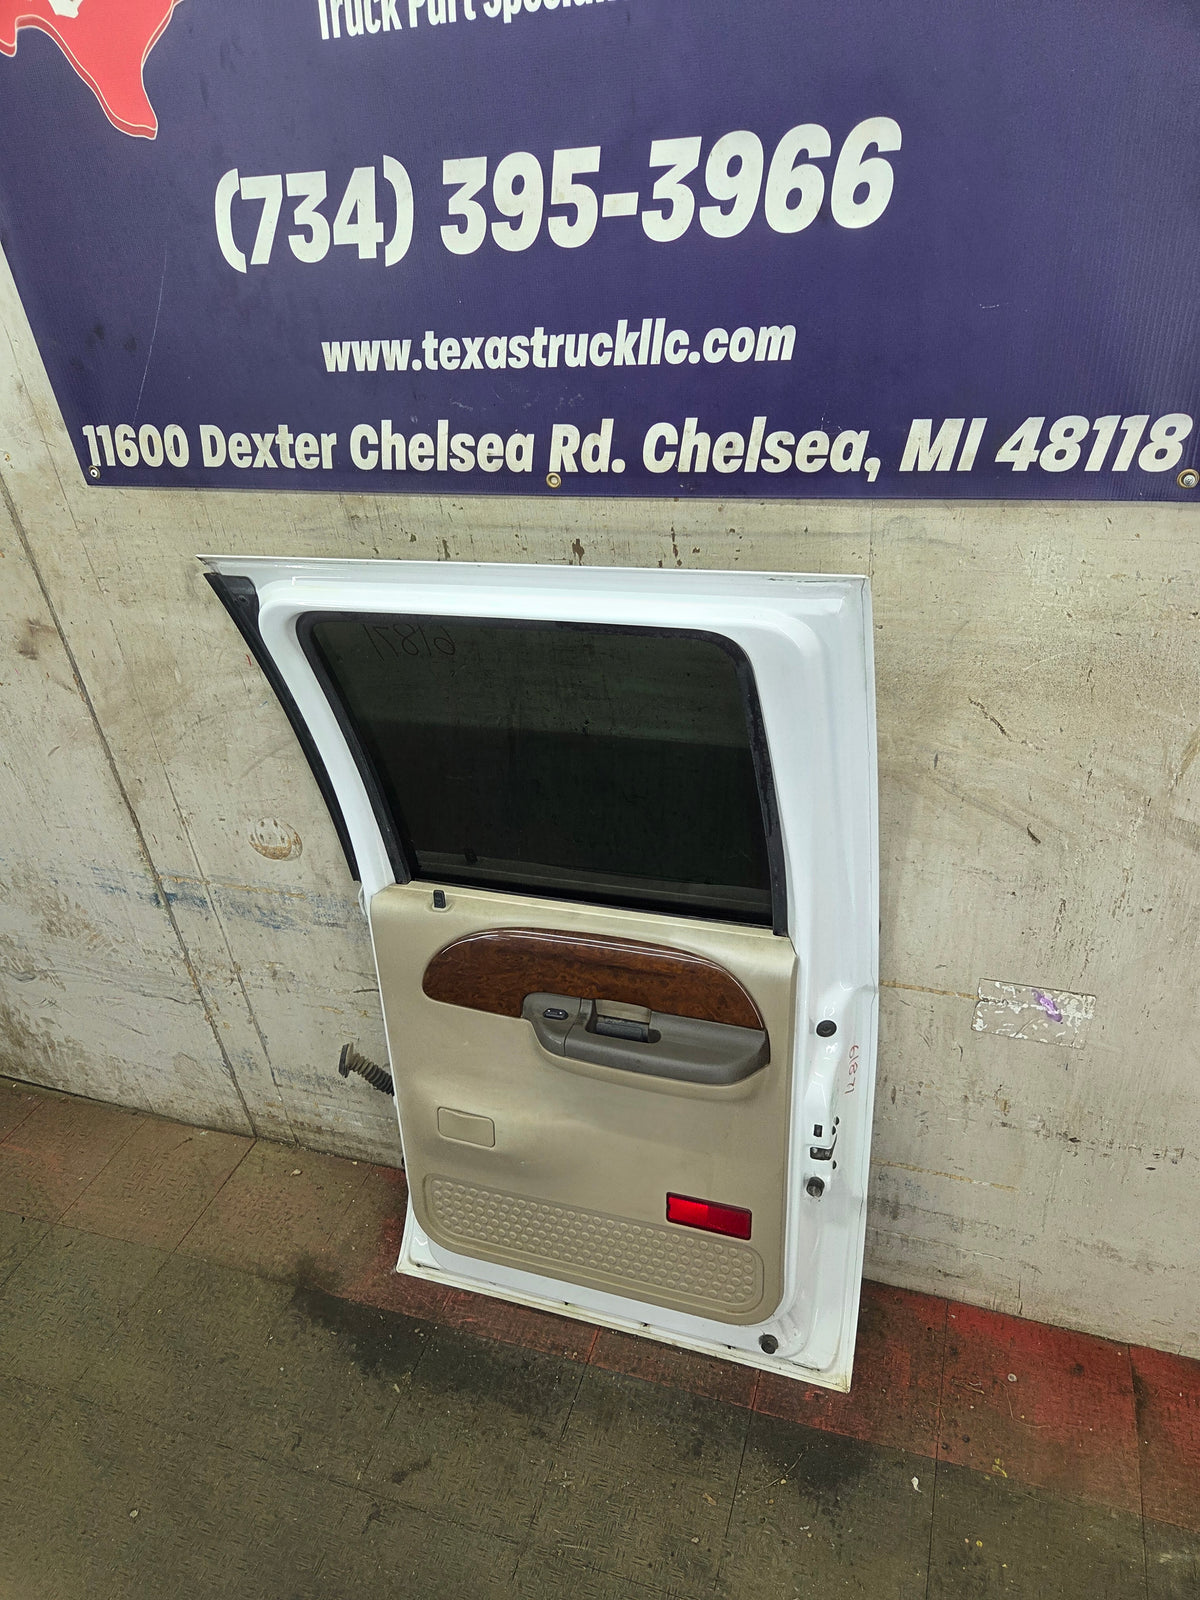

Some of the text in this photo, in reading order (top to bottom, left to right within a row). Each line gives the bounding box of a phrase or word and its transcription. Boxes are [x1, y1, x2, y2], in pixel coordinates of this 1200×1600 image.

[214, 116, 903, 273] (734) 395-3966
[321, 317, 797, 373] www.texastruckllc.com
[82, 412, 1194, 483] 11600 Dexter Chelsea Rd. Chelsea, MI 48118
